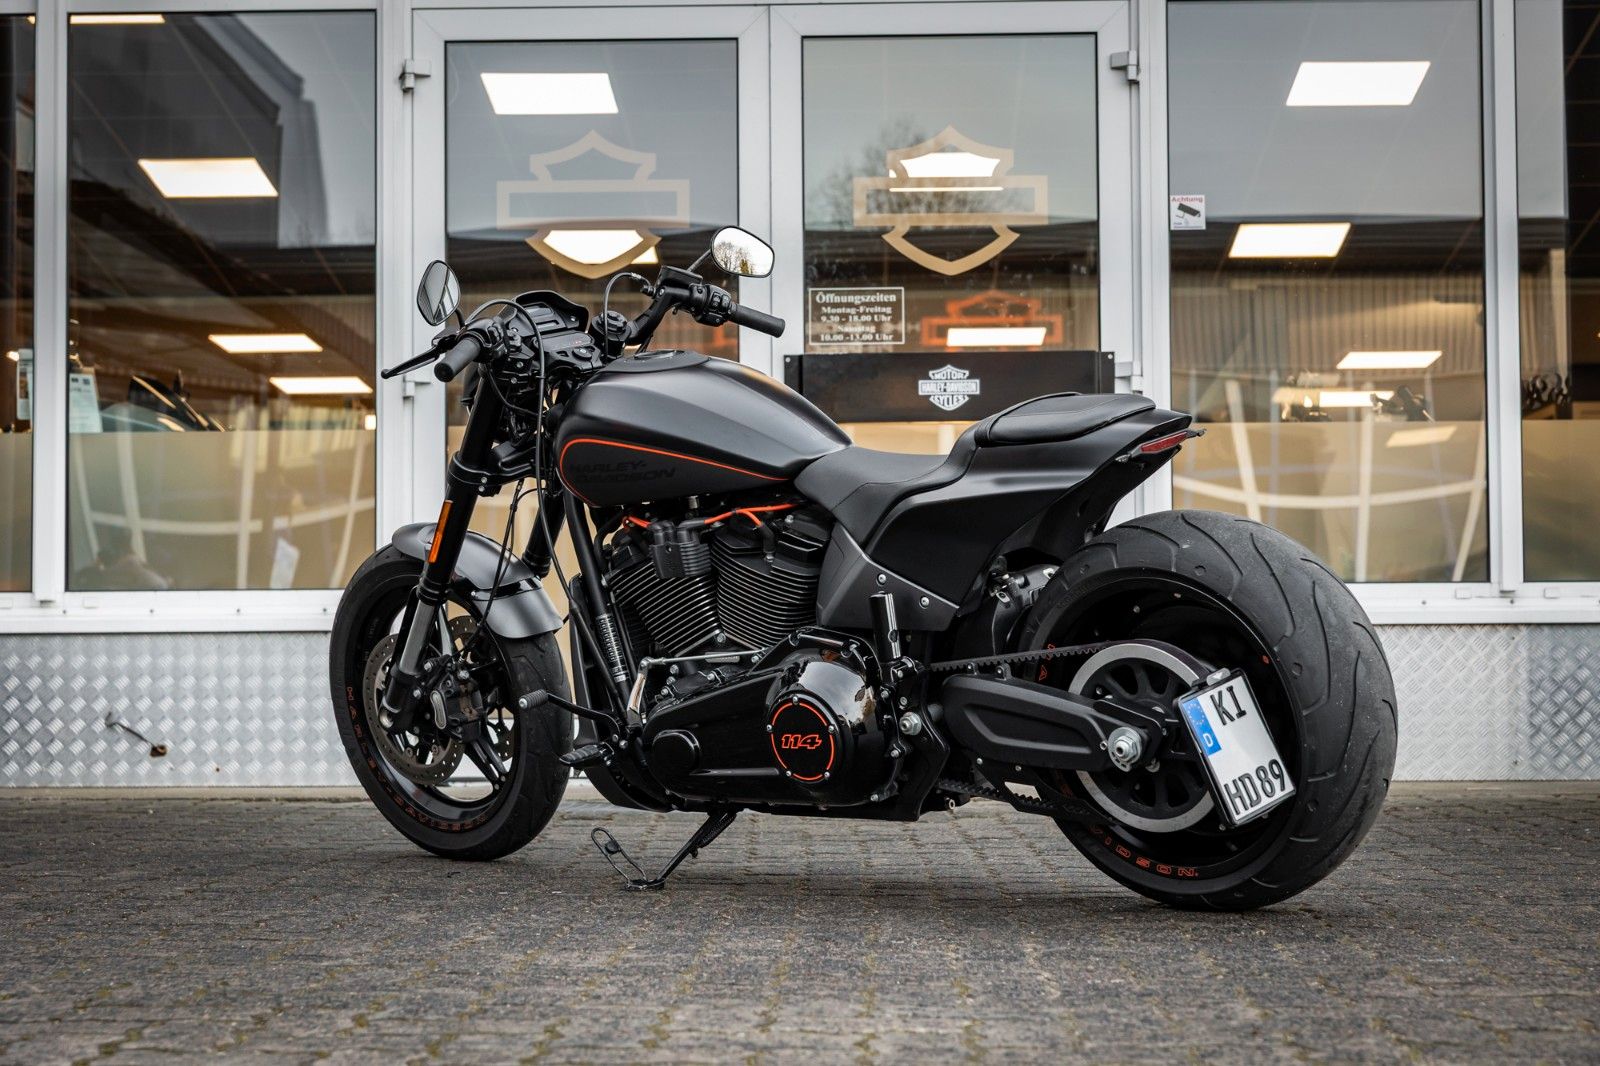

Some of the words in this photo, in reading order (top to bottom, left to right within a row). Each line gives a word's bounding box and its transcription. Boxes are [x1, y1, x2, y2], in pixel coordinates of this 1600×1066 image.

[815, 291, 896, 305] Öffnungszeiten
[821, 306, 892, 314] Montag-Freitag
[934, 369, 965, 380] MOTOR
[1210, 685, 1247, 726] KI
[781, 733, 823, 750] 114
[1203, 733, 1214, 747] D
[1224, 758, 1286, 816] HD89
